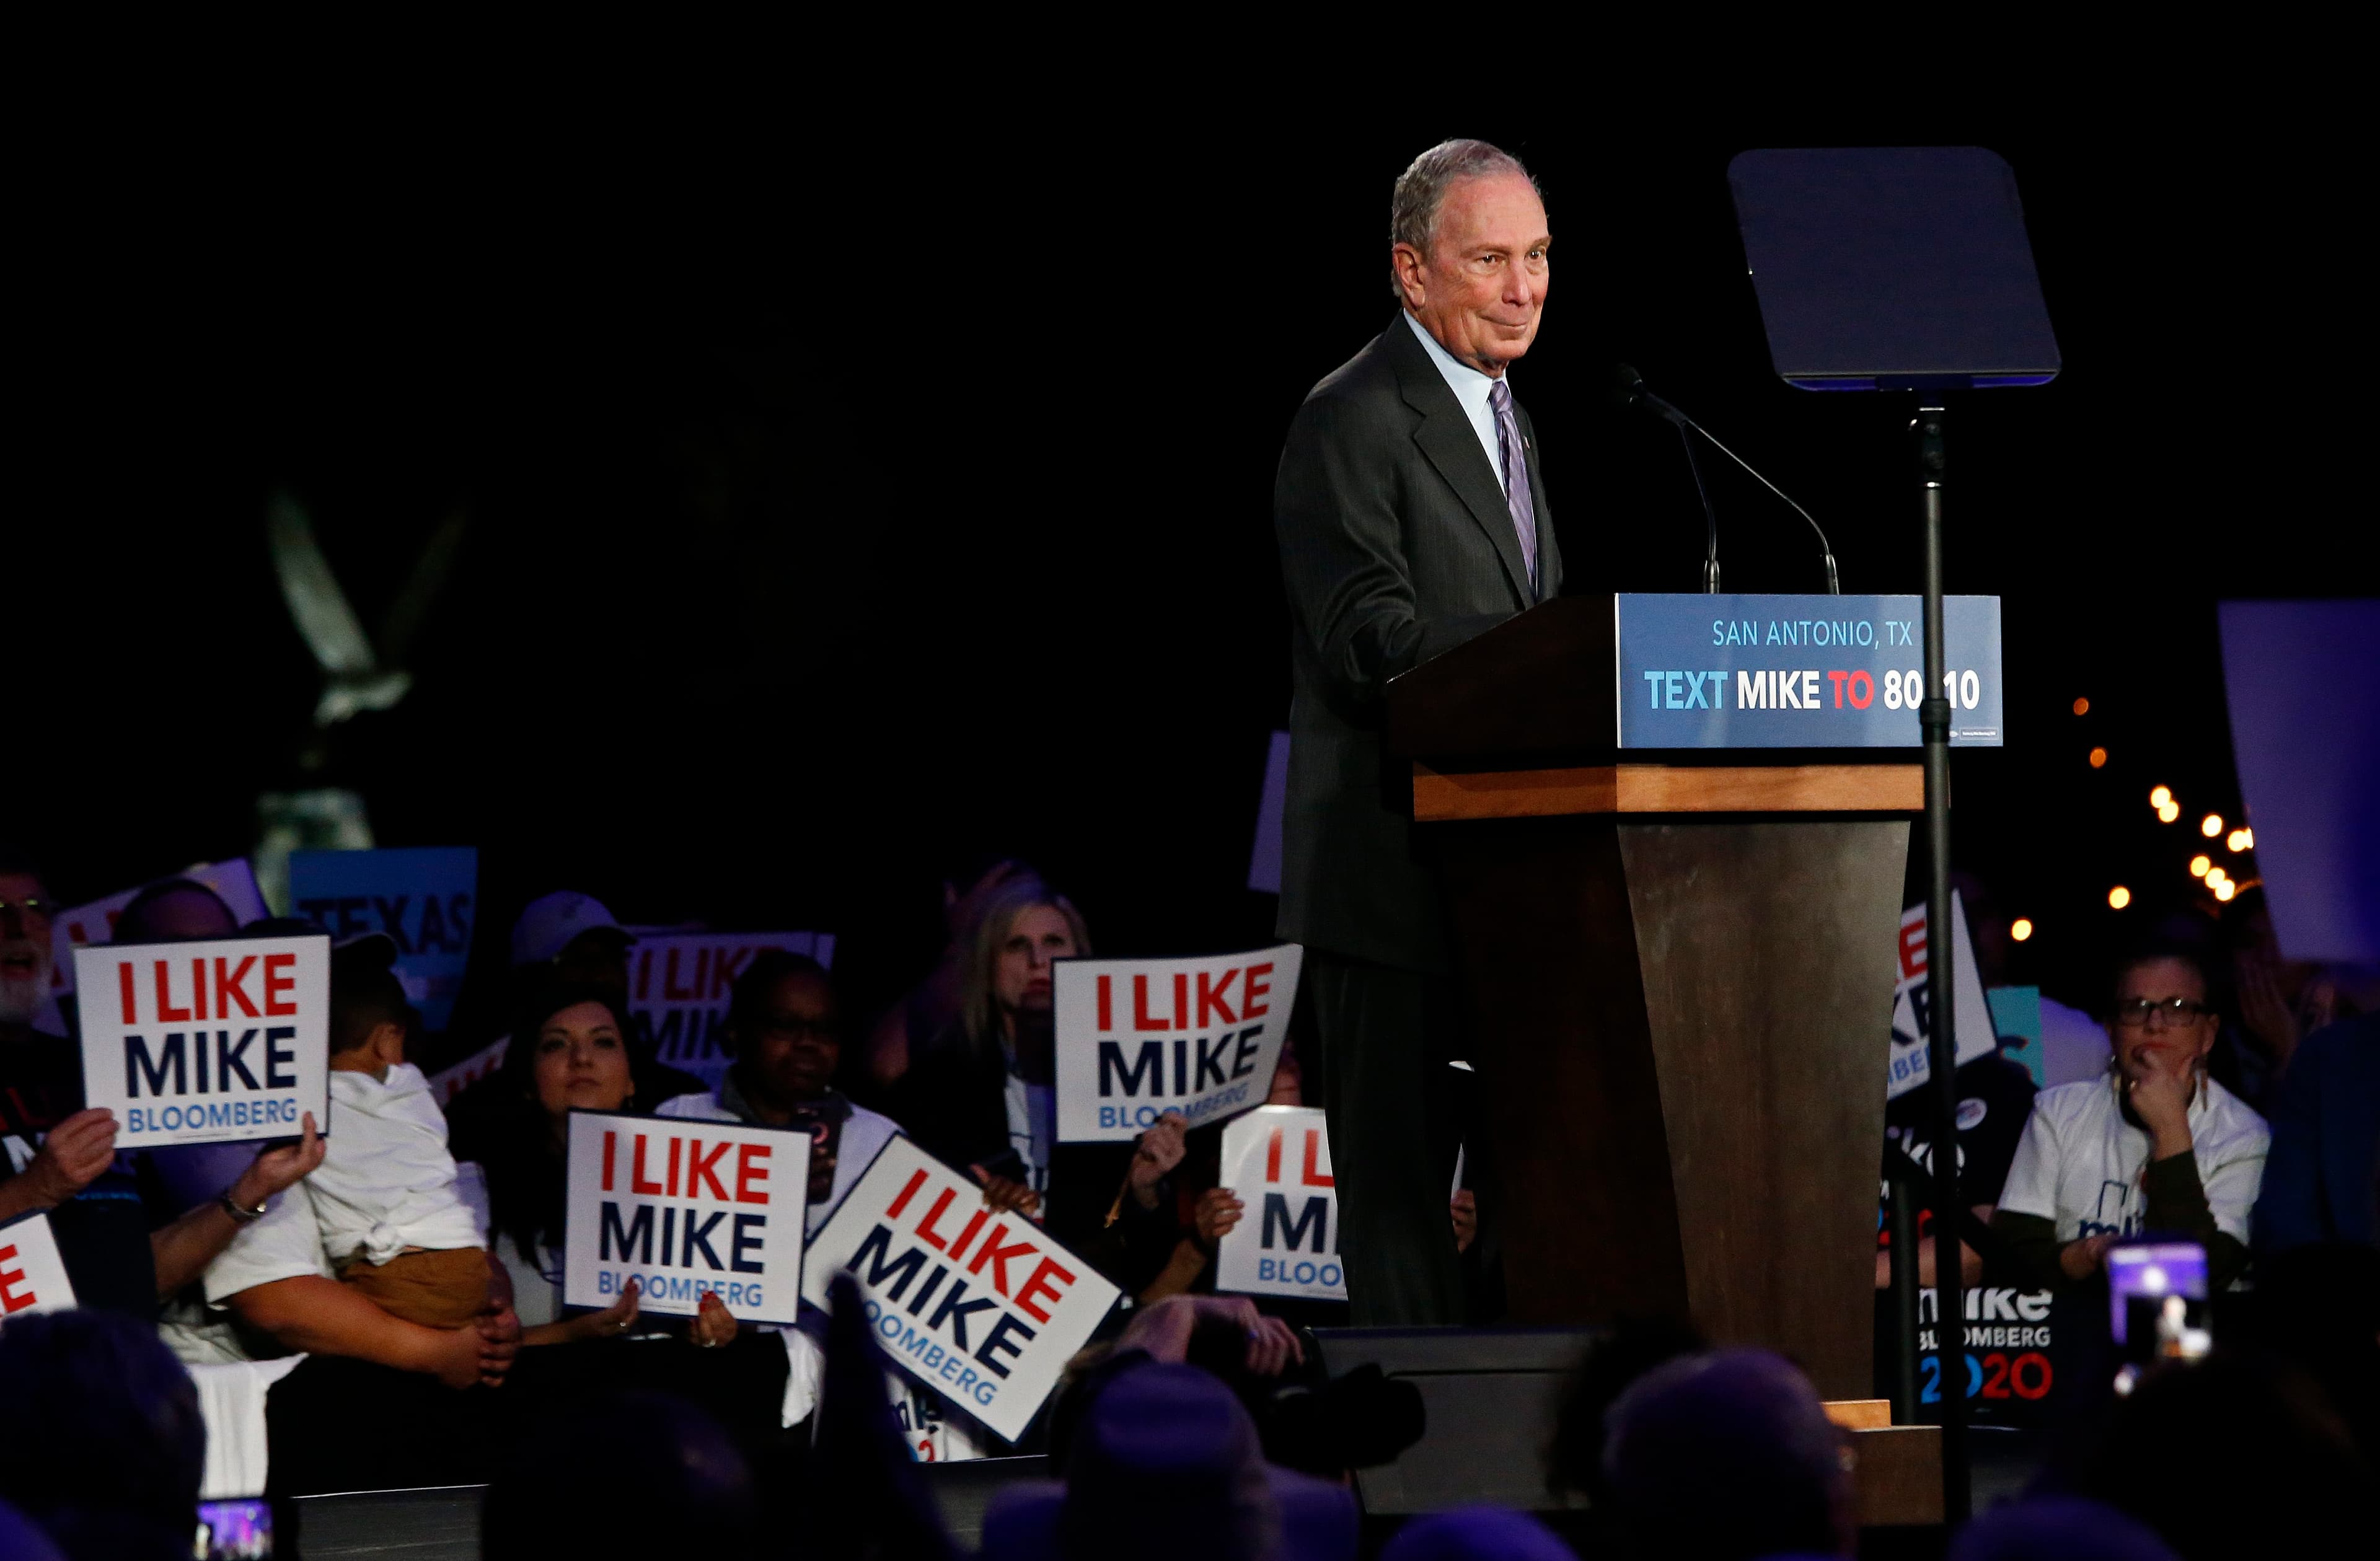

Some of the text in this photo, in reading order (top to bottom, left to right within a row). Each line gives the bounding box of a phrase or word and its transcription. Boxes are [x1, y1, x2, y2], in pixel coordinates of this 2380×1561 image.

[1712, 620, 1913, 650] SAN ANTONIO, TX
[1644, 669, 1980, 710] TEXT MIKE TO 8010
[118, 954, 297, 1024] I LIKE
[637, 946, 783, 1001] I LIK
[1097, 962, 1274, 1031] I LIKE
[124, 1027, 296, 1098] MIKE
[1099, 1024, 1264, 1096] MIKE
[128, 1098, 297, 1133] BLOOMBERG
[602, 1132, 772, 1204] I LIKE
[1266, 1126, 1284, 1182] I
[599, 1202, 766, 1274] MIKE
[886, 1168, 1077, 1325] I LIKE
[846, 1223, 1036, 1380] MIKE
